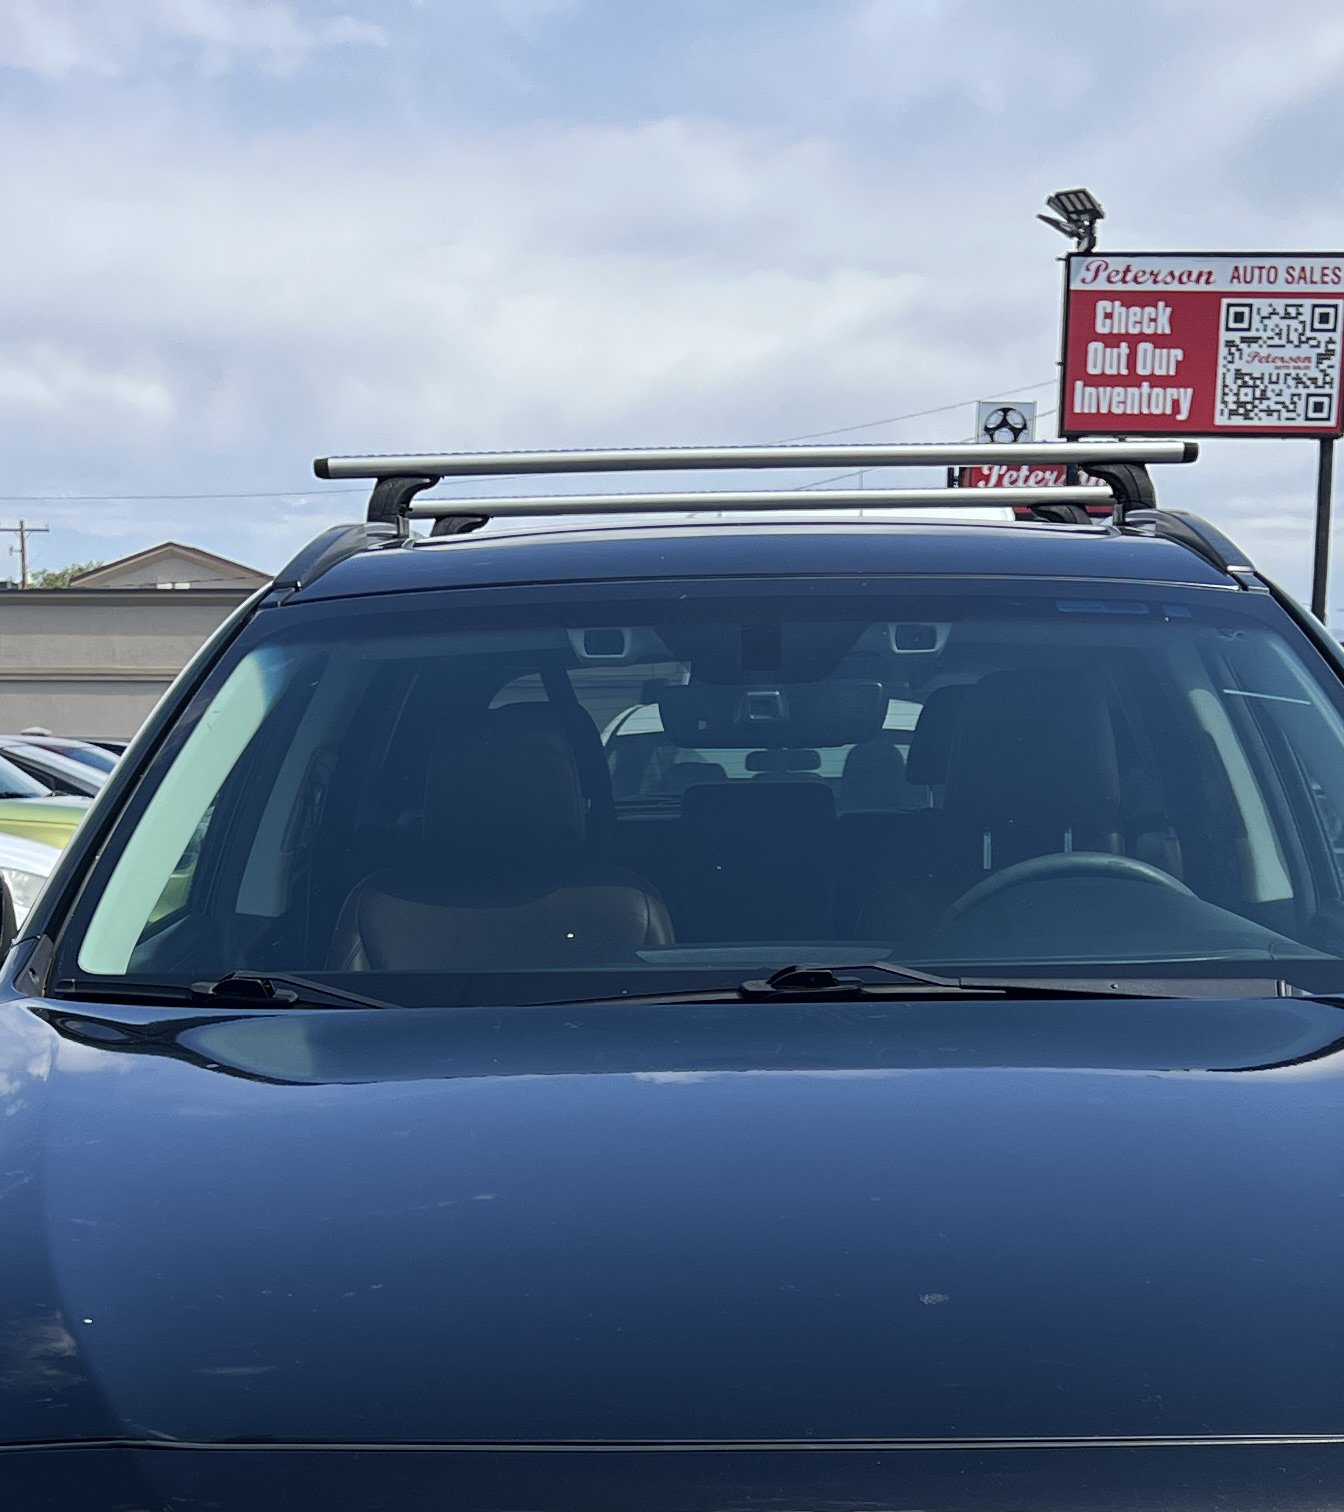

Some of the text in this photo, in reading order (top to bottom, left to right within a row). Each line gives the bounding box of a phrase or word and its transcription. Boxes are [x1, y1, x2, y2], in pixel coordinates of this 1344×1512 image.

[1080, 259, 1342, 286] Peterson AUTO SALES
[1094, 299, 1173, 335] Check
[1086, 341, 1184, 377] Out Our
[1072, 380, 1194, 421] Inventory
